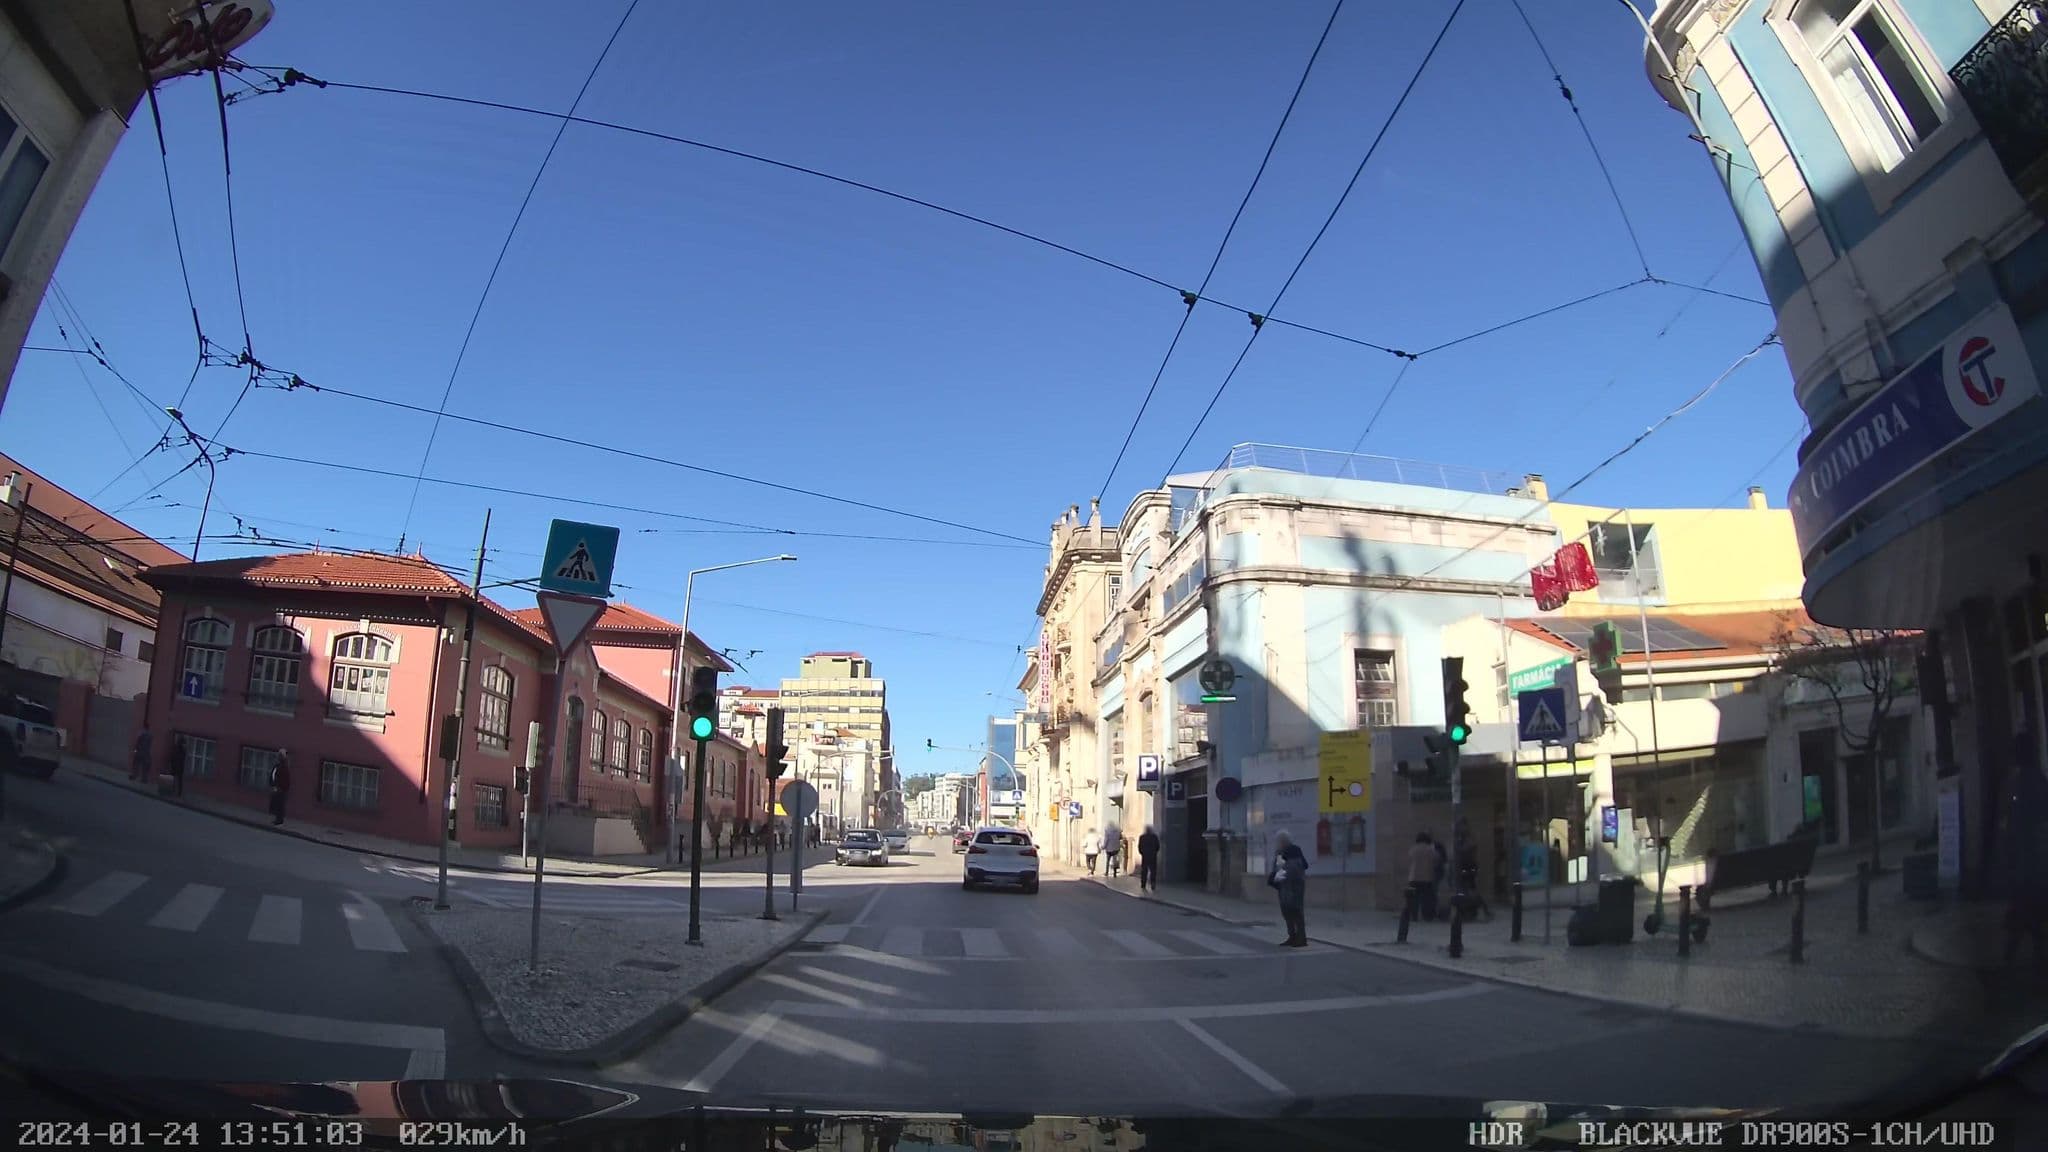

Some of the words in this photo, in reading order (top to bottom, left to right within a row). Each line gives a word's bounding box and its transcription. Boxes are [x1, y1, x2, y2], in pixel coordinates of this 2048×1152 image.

[1810, 402, 1911, 499] COIMBRA
[1141, 757, 1157, 779] P
[1171, 782, 1183, 798] P
